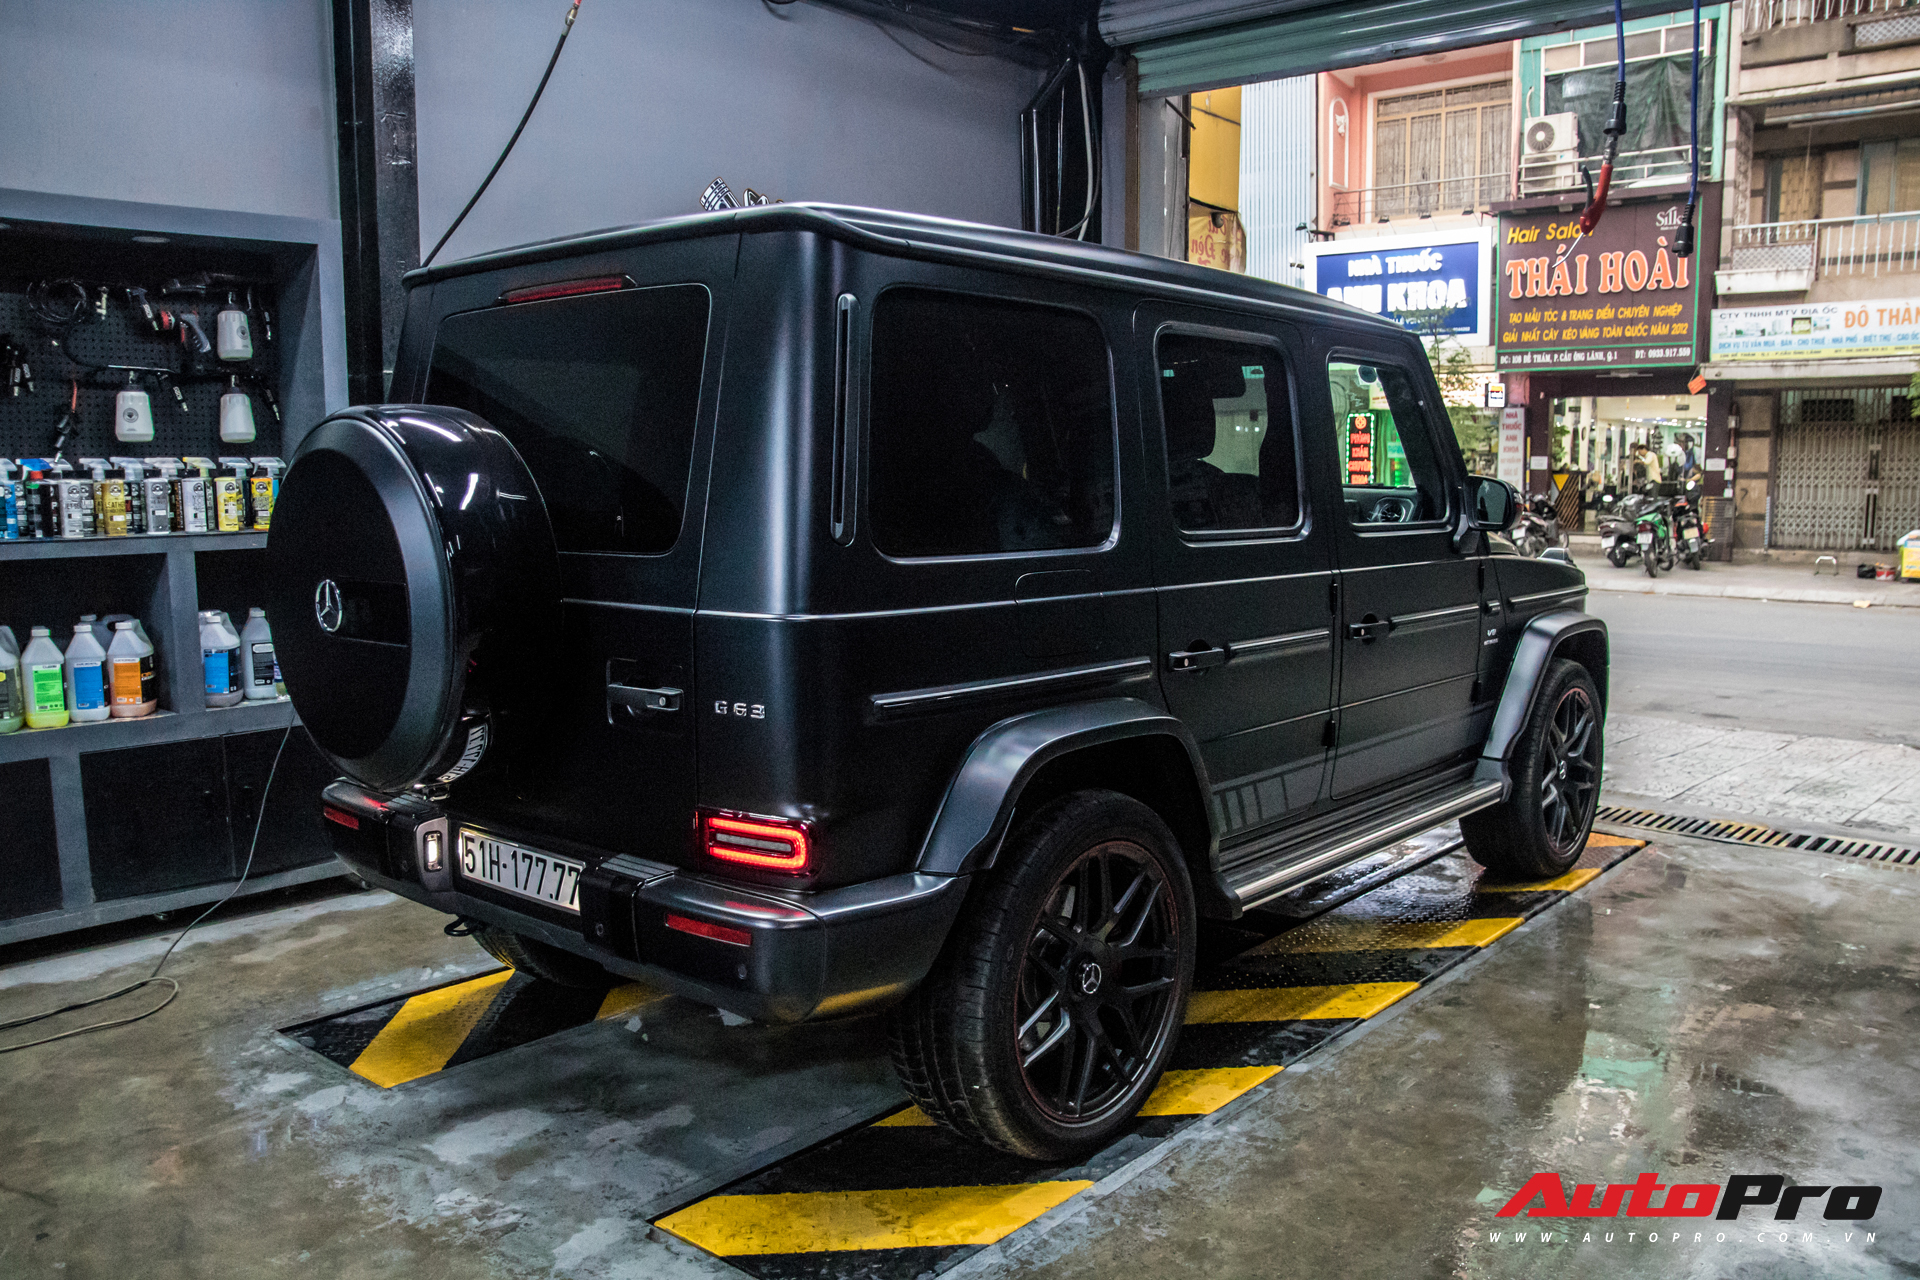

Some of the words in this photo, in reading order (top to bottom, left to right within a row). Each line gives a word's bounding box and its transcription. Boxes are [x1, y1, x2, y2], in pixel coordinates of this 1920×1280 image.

[1507, 225, 1541, 245] Hair
[1348, 254, 1383, 278] NHÀ
[1385, 248, 1443, 275] THUỐC
[1506, 243, 1589, 299] THÁI
[1599, 236, 1690, 293] HOÀI
[1387, 278, 1468, 312] KHOA
[1509, 312, 1523, 326] TẠO
[1544, 308, 1558, 322] TÓC
[1569, 309, 1594, 320] TRANG
[1617, 303, 1650, 319] CHUYÊN
[1653, 302, 1683, 318] NGHIỆP
[1844, 305, 1869, 328] ĐÔ
[1624, 322, 1649, 337] QUỐC
[1671, 323, 1689, 335] 2012
[463, 836, 582, 906] 51H-177.77
